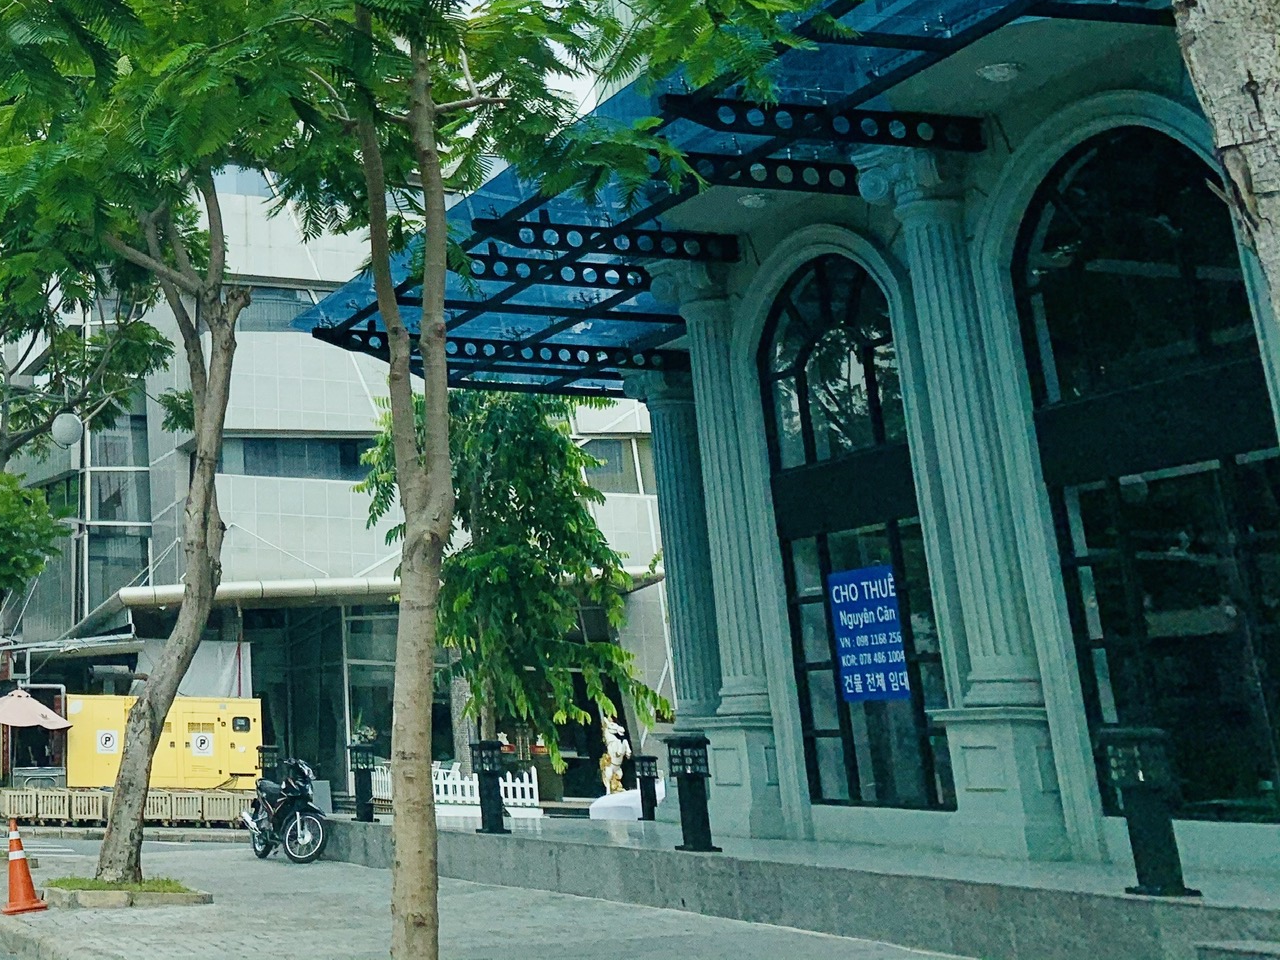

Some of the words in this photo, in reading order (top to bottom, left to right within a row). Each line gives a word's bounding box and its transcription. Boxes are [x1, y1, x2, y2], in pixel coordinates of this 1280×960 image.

[832, 583, 858, 604] CHO
[861, 572, 896, 600] THUÊ
[839, 607, 875, 630] Nguyên
[840, 637, 851, 648] VN
[888, 631, 902, 644] 256
[844, 673, 864, 694] 건물
[865, 671, 887, 692] 전체
[888, 670, 910, 692] 임대
